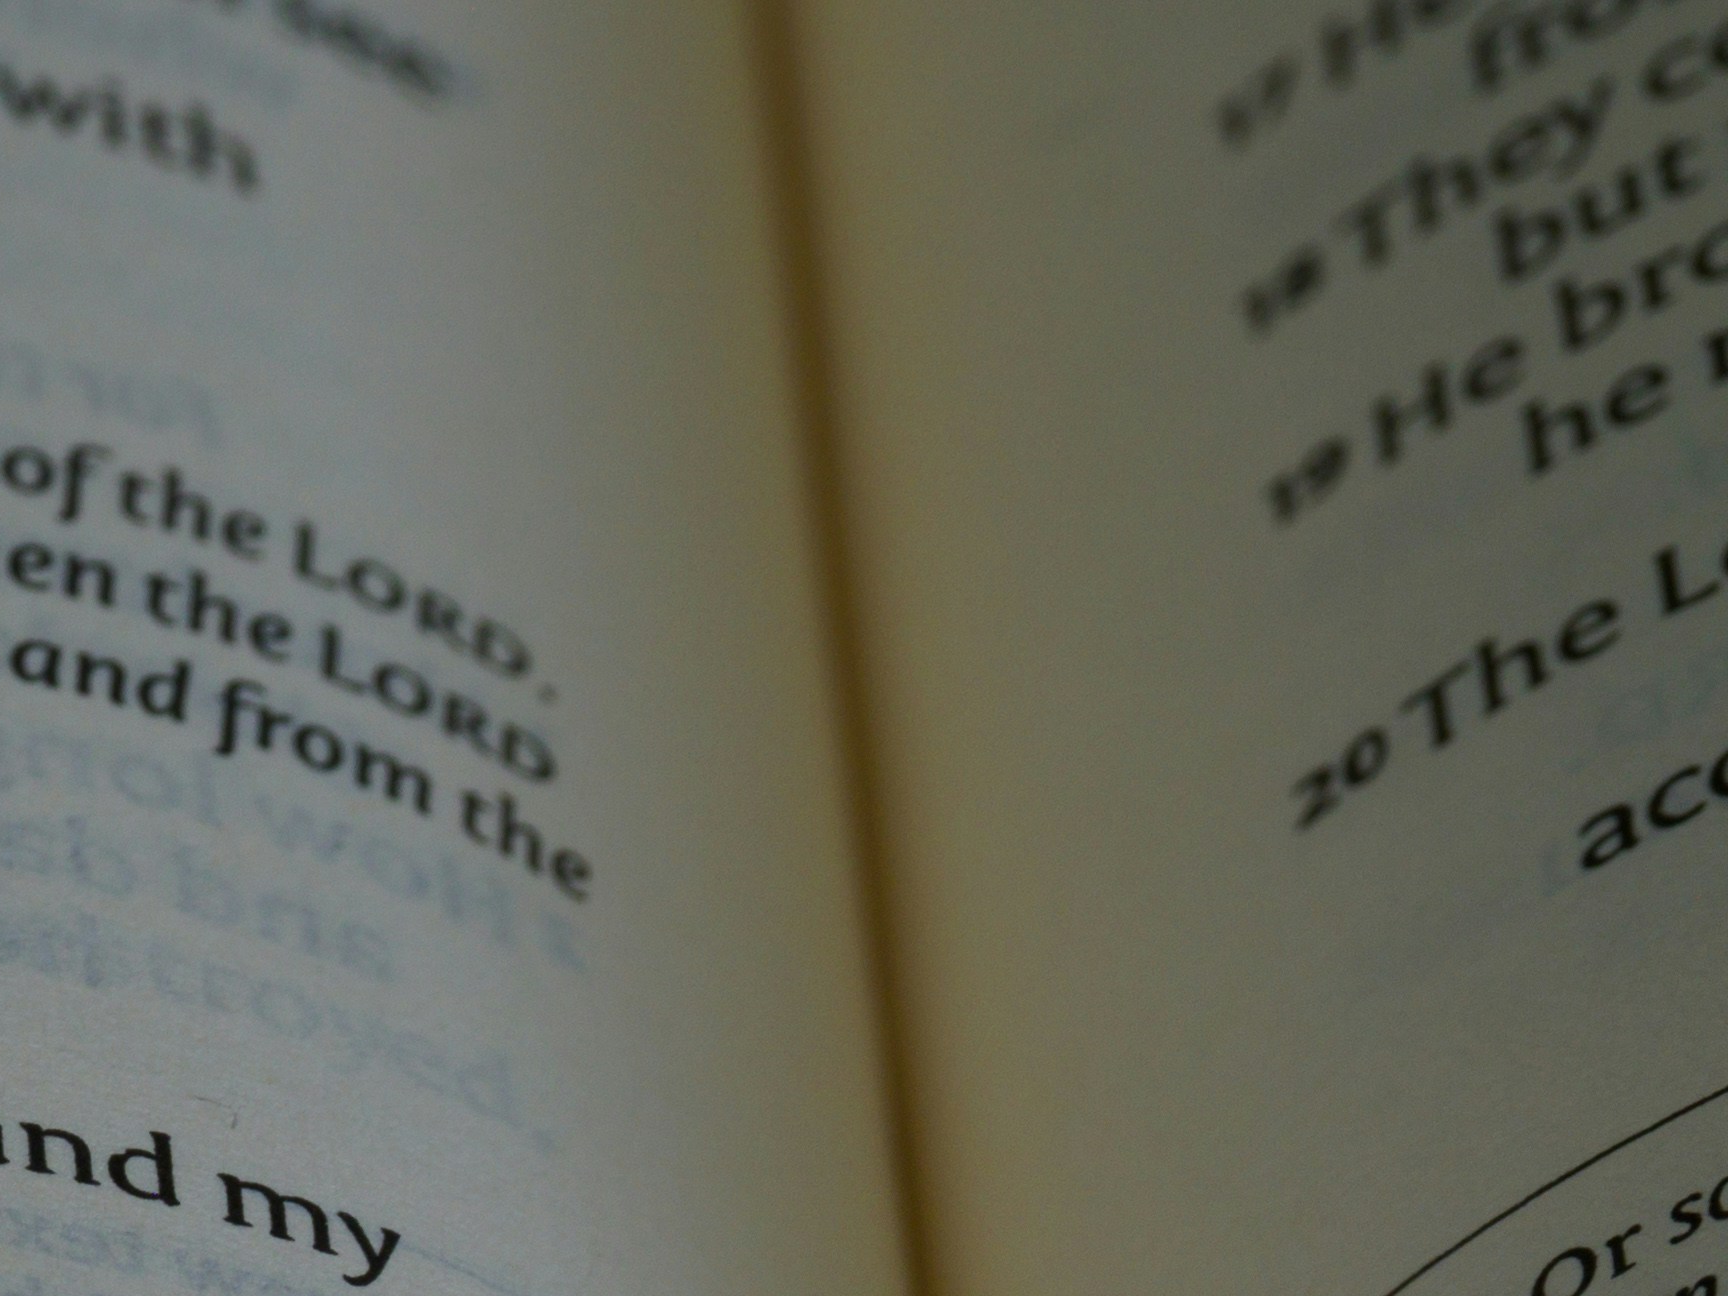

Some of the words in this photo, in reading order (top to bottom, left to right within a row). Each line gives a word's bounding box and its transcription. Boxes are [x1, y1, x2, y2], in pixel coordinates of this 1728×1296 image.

[1344, 78, 1614, 270] They
[1494, 138, 1702, 282] but
[1372, 335, 1524, 466] He
[1521, 363, 1670, 477] he
[118, 468, 267, 558] the
[291, 520, 557, 706] LORD.
[144, 568, 294, 662] the
[319, 620, 559, 787] LORD
[9, 636, 192, 724] and
[214, 672, 436, 816] from
[459, 788, 592, 900] the
[1294, 726, 1390, 831] 20
[1403, 598, 1620, 750] The
[1654, 545, 1728, 617] L
[216, 1170, 402, 1288] my
